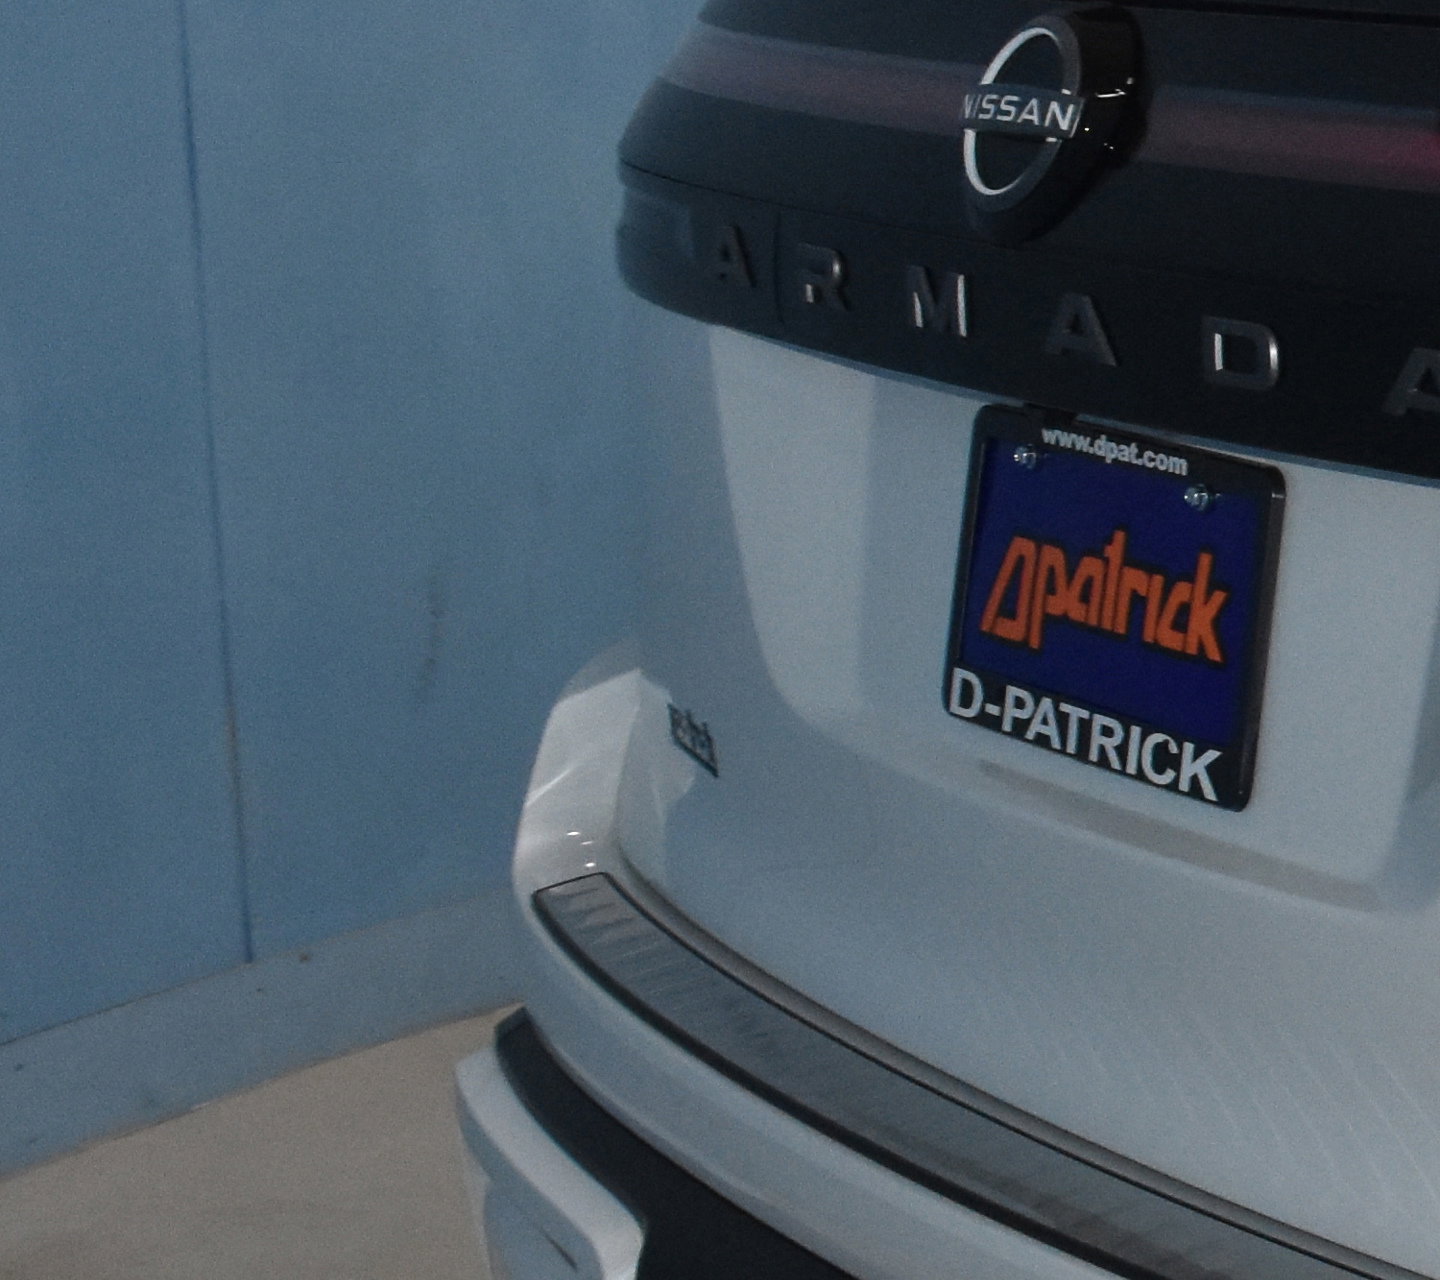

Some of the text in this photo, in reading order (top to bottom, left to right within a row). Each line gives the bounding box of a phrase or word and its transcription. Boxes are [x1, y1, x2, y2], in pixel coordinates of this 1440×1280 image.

[963, 93, 1075, 132] NISSAN
[1041, 428, 1189, 477] www.dpat.com
[948, 666, 1224, 802] D-PATRICK
